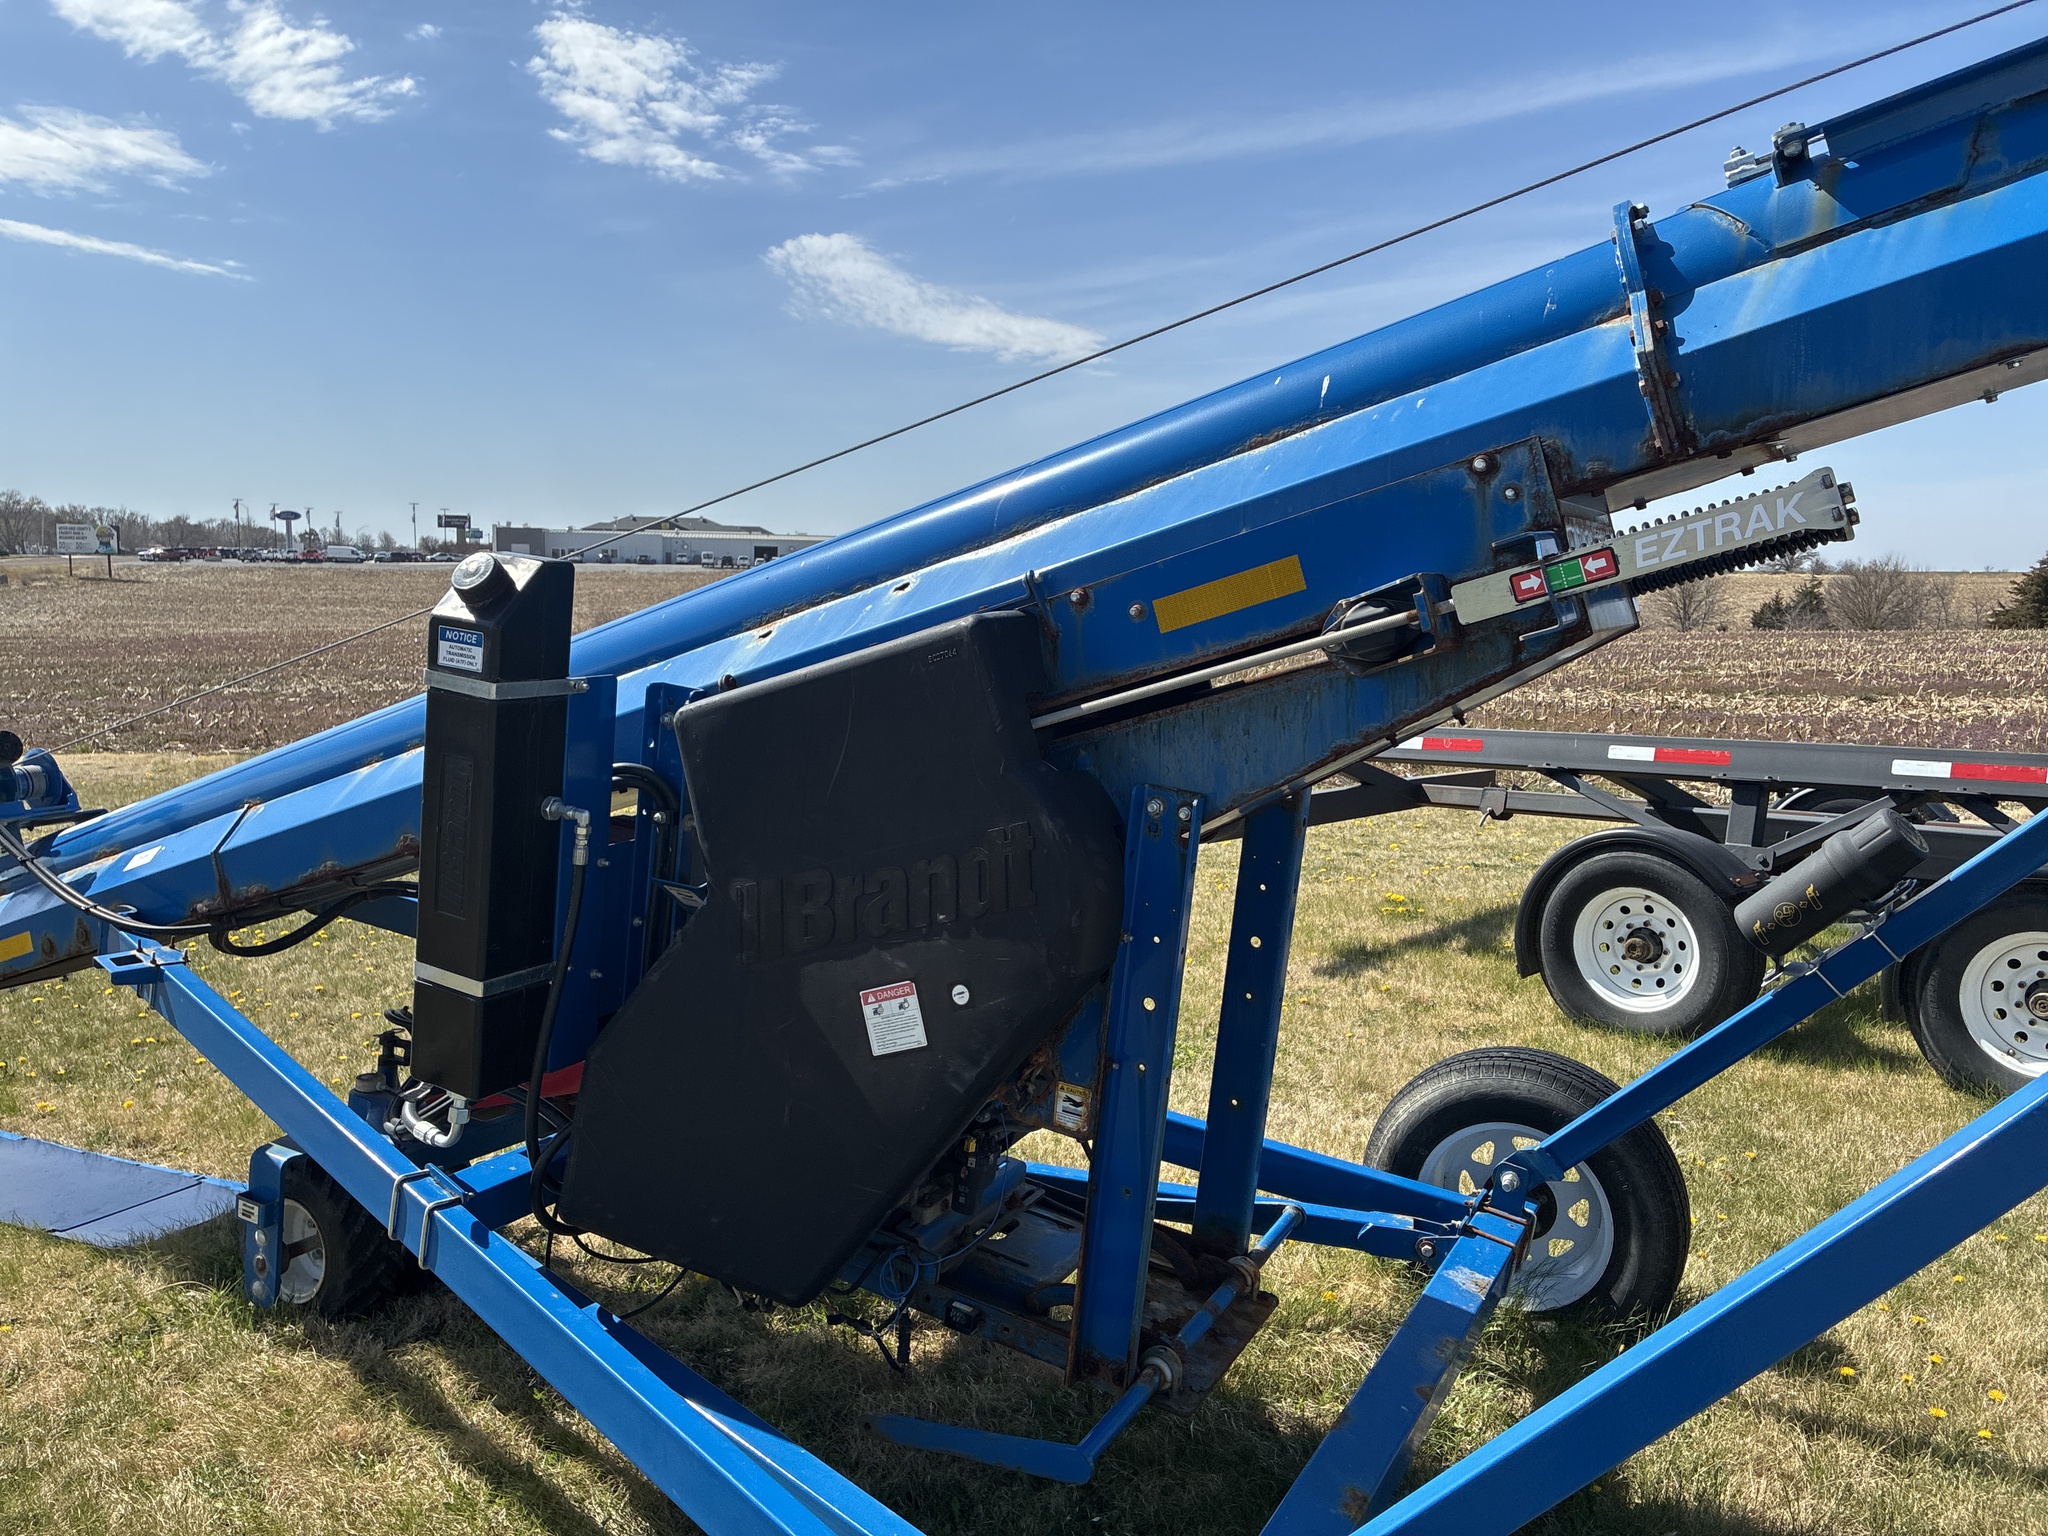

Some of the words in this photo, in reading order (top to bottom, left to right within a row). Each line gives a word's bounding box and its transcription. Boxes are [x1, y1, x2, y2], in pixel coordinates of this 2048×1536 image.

[1635, 491, 1806, 569] EZTRAK
[445, 630, 477, 643] NOTICE
[446, 650, 475, 660] TRANSMISSION
[449, 644, 472, 653] AUTOMATIC
[783, 821, 1038, 954] Brandt
[876, 985, 911, 1000] DANGER
